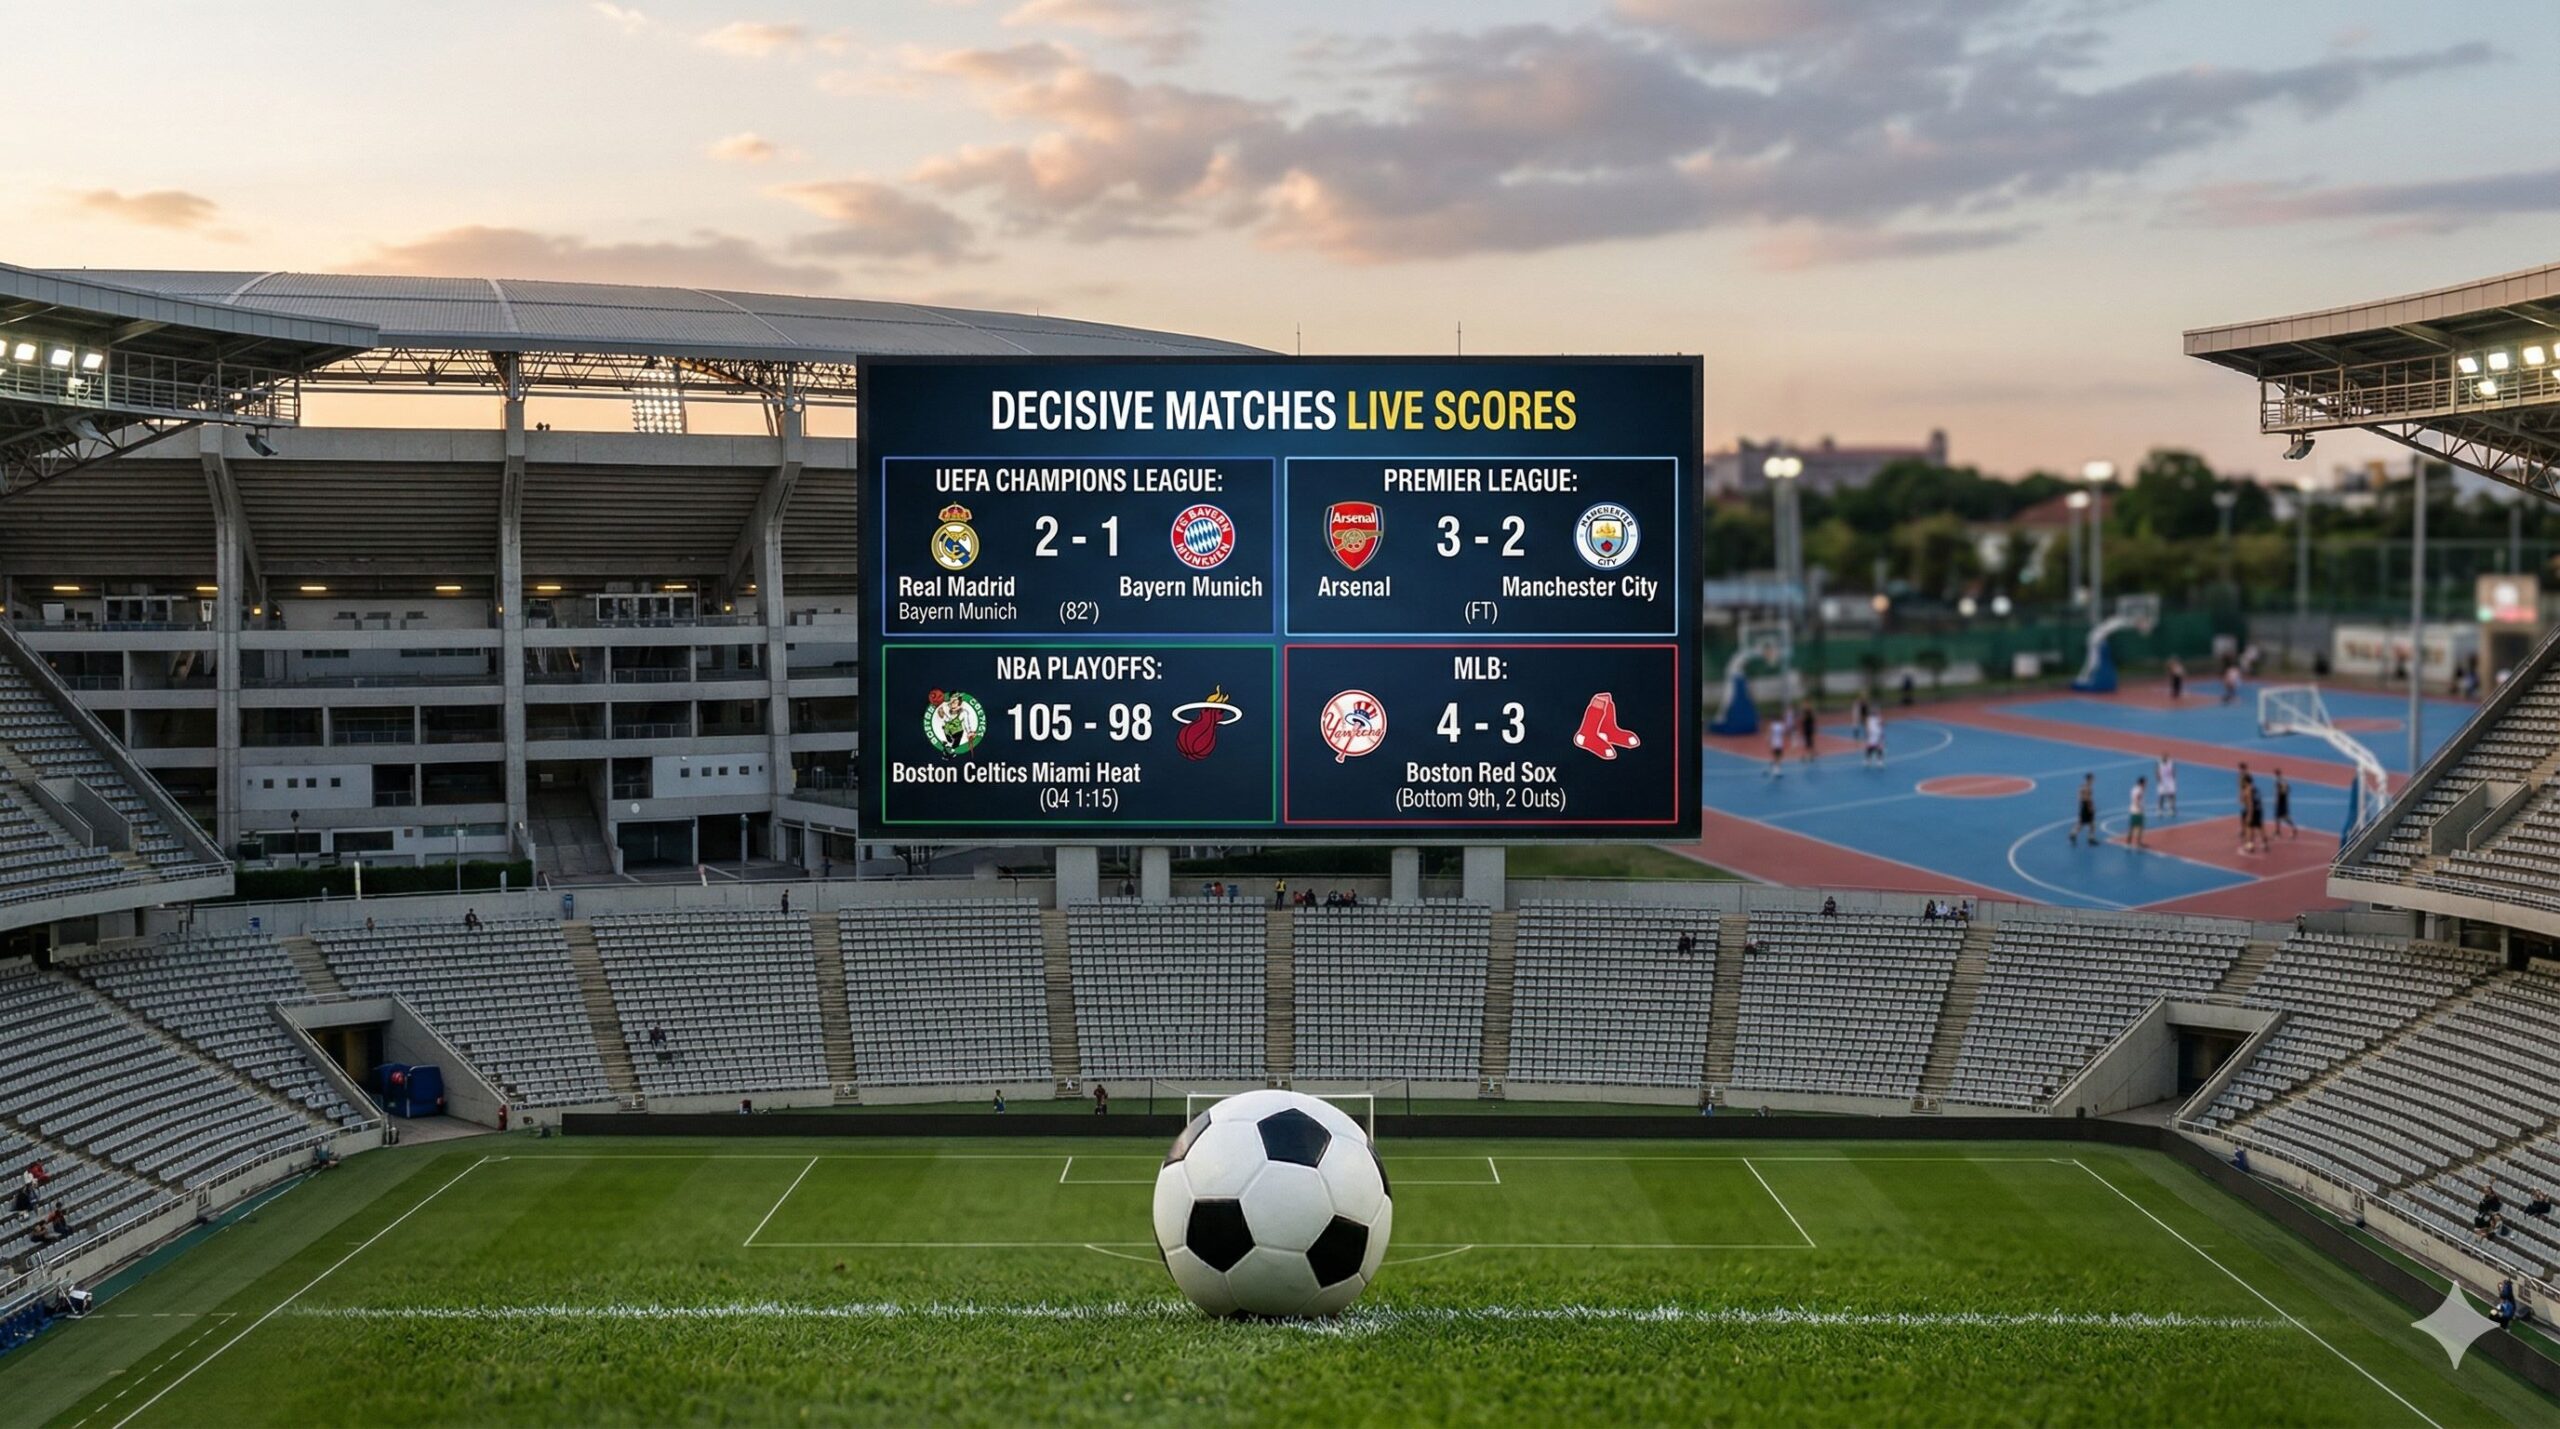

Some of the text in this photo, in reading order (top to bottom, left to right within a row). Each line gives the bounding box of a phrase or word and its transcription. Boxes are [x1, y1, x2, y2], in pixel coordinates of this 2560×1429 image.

[992, 389, 1577, 431] DECISIVE MATCHES LIVE SCORES
[936, 468, 1223, 492] UEFA CHAMPIONS LEAGUE:
[1384, 468, 1578, 492] PREMIER LEAGUE:
[1332, 512, 1376, 524] Arsenal
[1035, 515, 1059, 557] 2
[1101, 515, 1118, 557] 1
[1436, 515, 1461, 558] 3
[1502, 515, 1525, 557] 2
[1597, 558, 1617, 566] CITY
[899, 575, 1015, 597] Real Madrid
[1119, 575, 1263, 601] Bayern Munich
[1317, 575, 1391, 597] Arsenal
[1502, 575, 1658, 602] Manchester City
[899, 602, 1017, 624] Bayern Munich
[1059, 601, 1100, 625] (82')
[1464, 601, 1498, 625] (FT)
[997, 655, 1162, 681] NBA PLAYOFFS:
[1454, 656, 1508, 680] MLB:
[1007, 703, 1073, 741] 105
[1109, 703, 1152, 741] 98
[1436, 702, 1461, 743] 4
[1501, 702, 1525, 744] 3
[892, 761, 1141, 783] Boston Celtics Miami Heat
[1406, 761, 1557, 783] Boston Red Sox
[1040, 787, 1119, 813] (Q4 1:15)
[1395, 787, 1566, 813] (Bottom 9th, 2 Outs)
